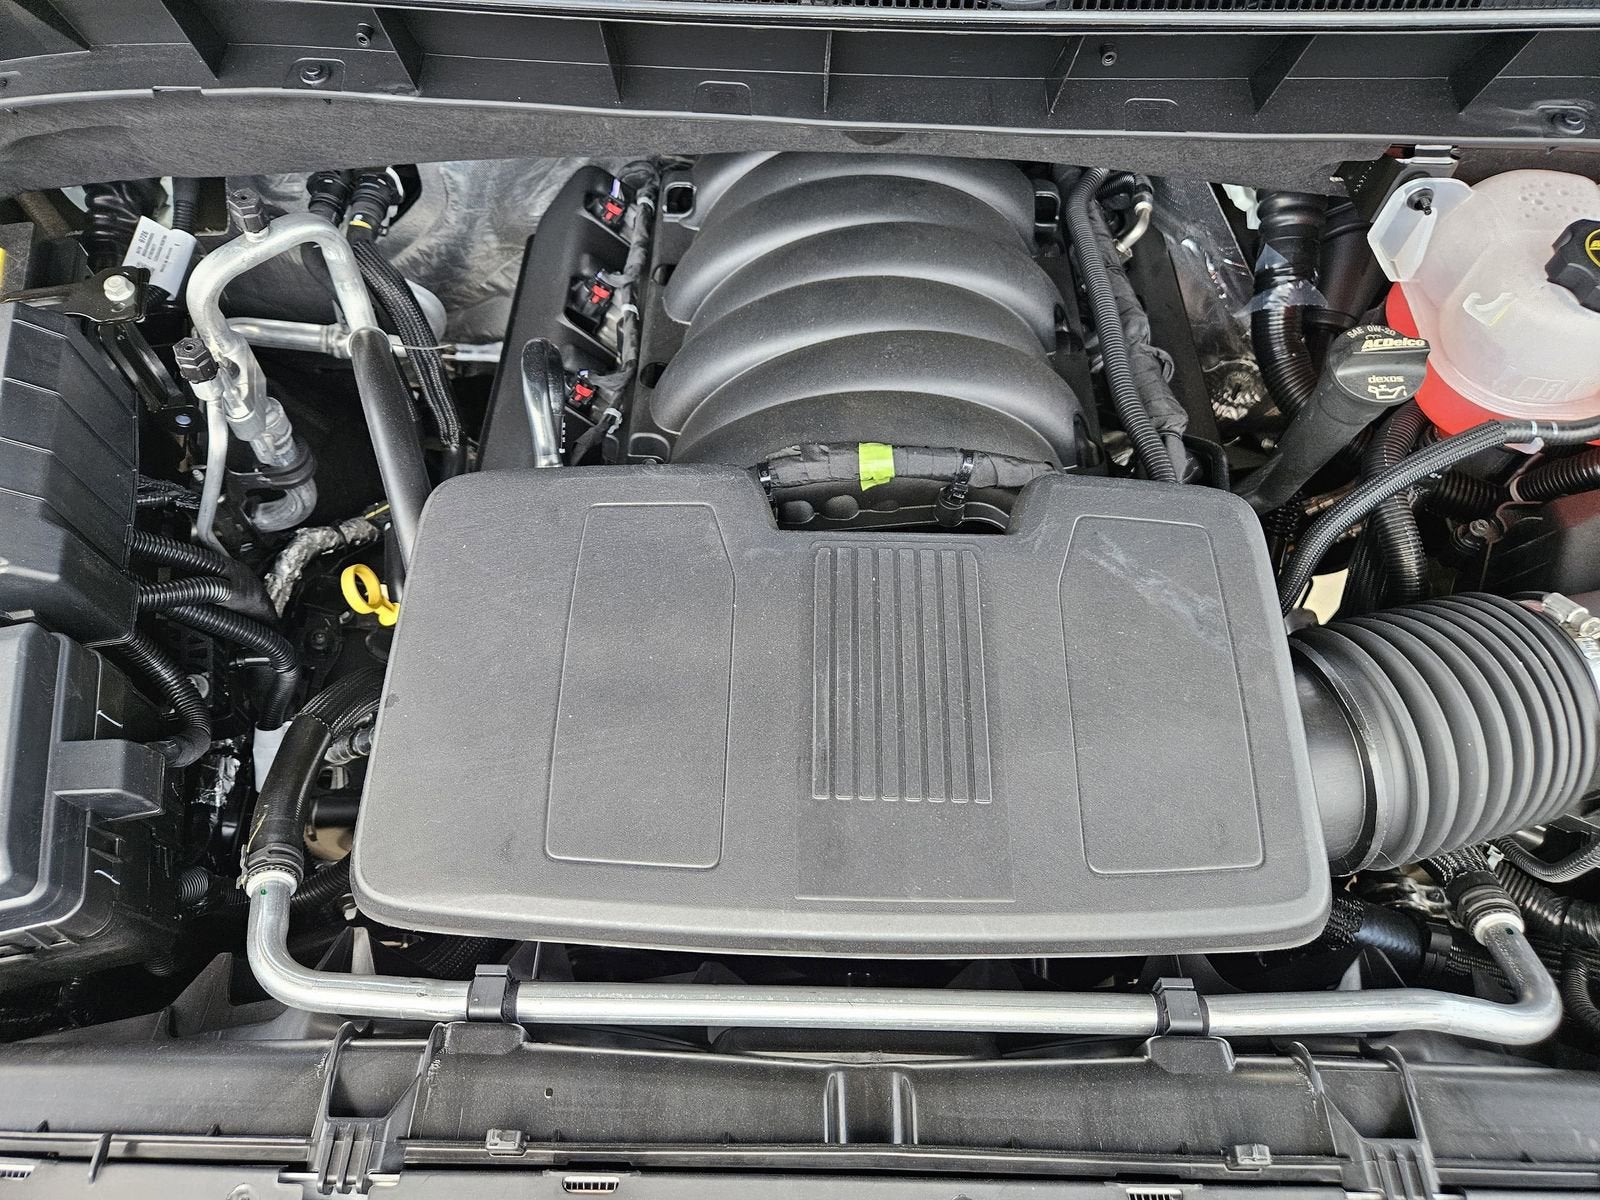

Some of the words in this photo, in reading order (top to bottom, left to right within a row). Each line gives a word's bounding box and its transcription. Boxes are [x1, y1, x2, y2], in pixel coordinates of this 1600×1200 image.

[1346, 326, 1365, 339] SAE
[1366, 324, 1396, 336] 0W-20
[1361, 337, 1426, 351] ACDelco
[1367, 374, 1405, 384] dexos
